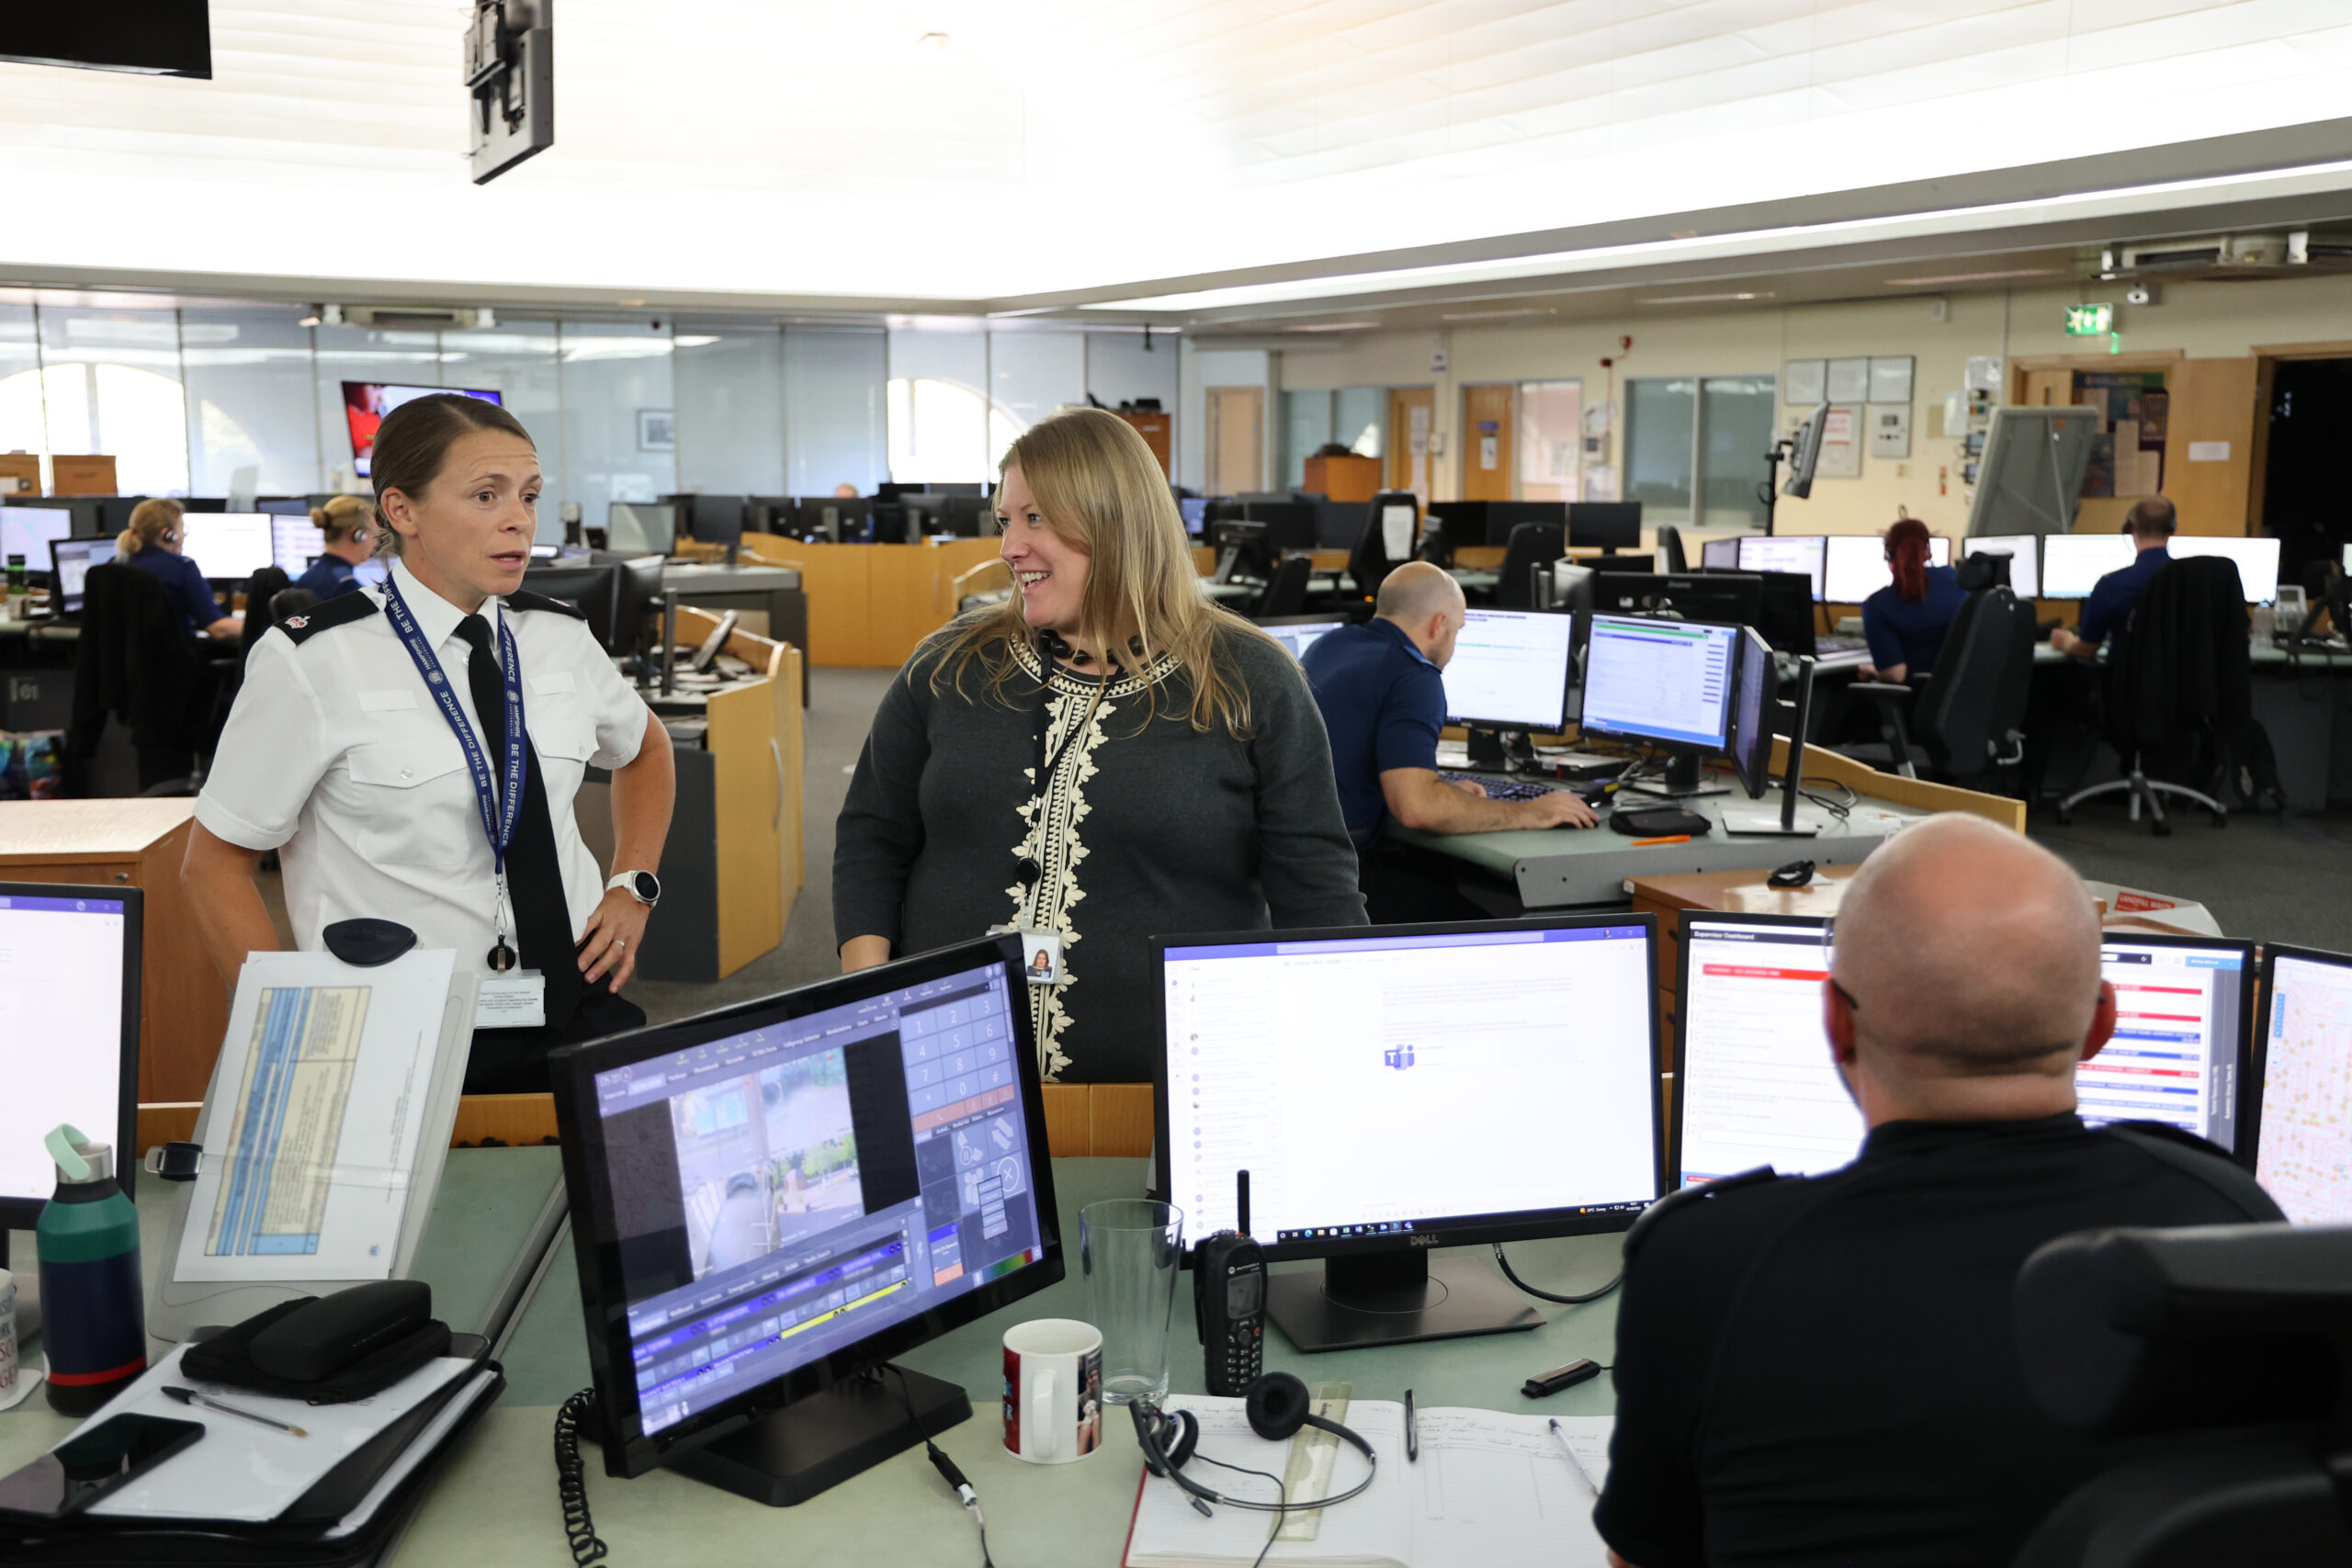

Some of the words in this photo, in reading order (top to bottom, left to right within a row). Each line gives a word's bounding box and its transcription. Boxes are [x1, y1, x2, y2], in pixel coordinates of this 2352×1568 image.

[390, 601, 406, 620] THE
[400, 619, 413, 634] BE
[409, 638, 432, 671] HAMPSHIRE
[440, 690, 476, 750] DIFFERENCE
[511, 743, 519, 757] BE
[470, 750, 483, 772] THE
[510, 760, 519, 779] THE
[480, 773, 488, 787] BE
[502, 782, 518, 846] DIFFERENCE
[1724, 932, 1755, 941] Dashboard
[916, 1021, 922, 1033] 1
[950, 1010, 957, 1024] 2
[983, 999, 990, 1013] 3
[919, 1044, 926, 1057] 4
[953, 1034, 960, 1048] 5
[986, 1023, 994, 1037] 6
[922, 1068, 929, 1082] 7
[956, 1058, 963, 1072] 8
[989, 1047, 996, 1061] 9
[959, 1081, 967, 1096] 0
[1410, 1235, 1439, 1247] DELL
